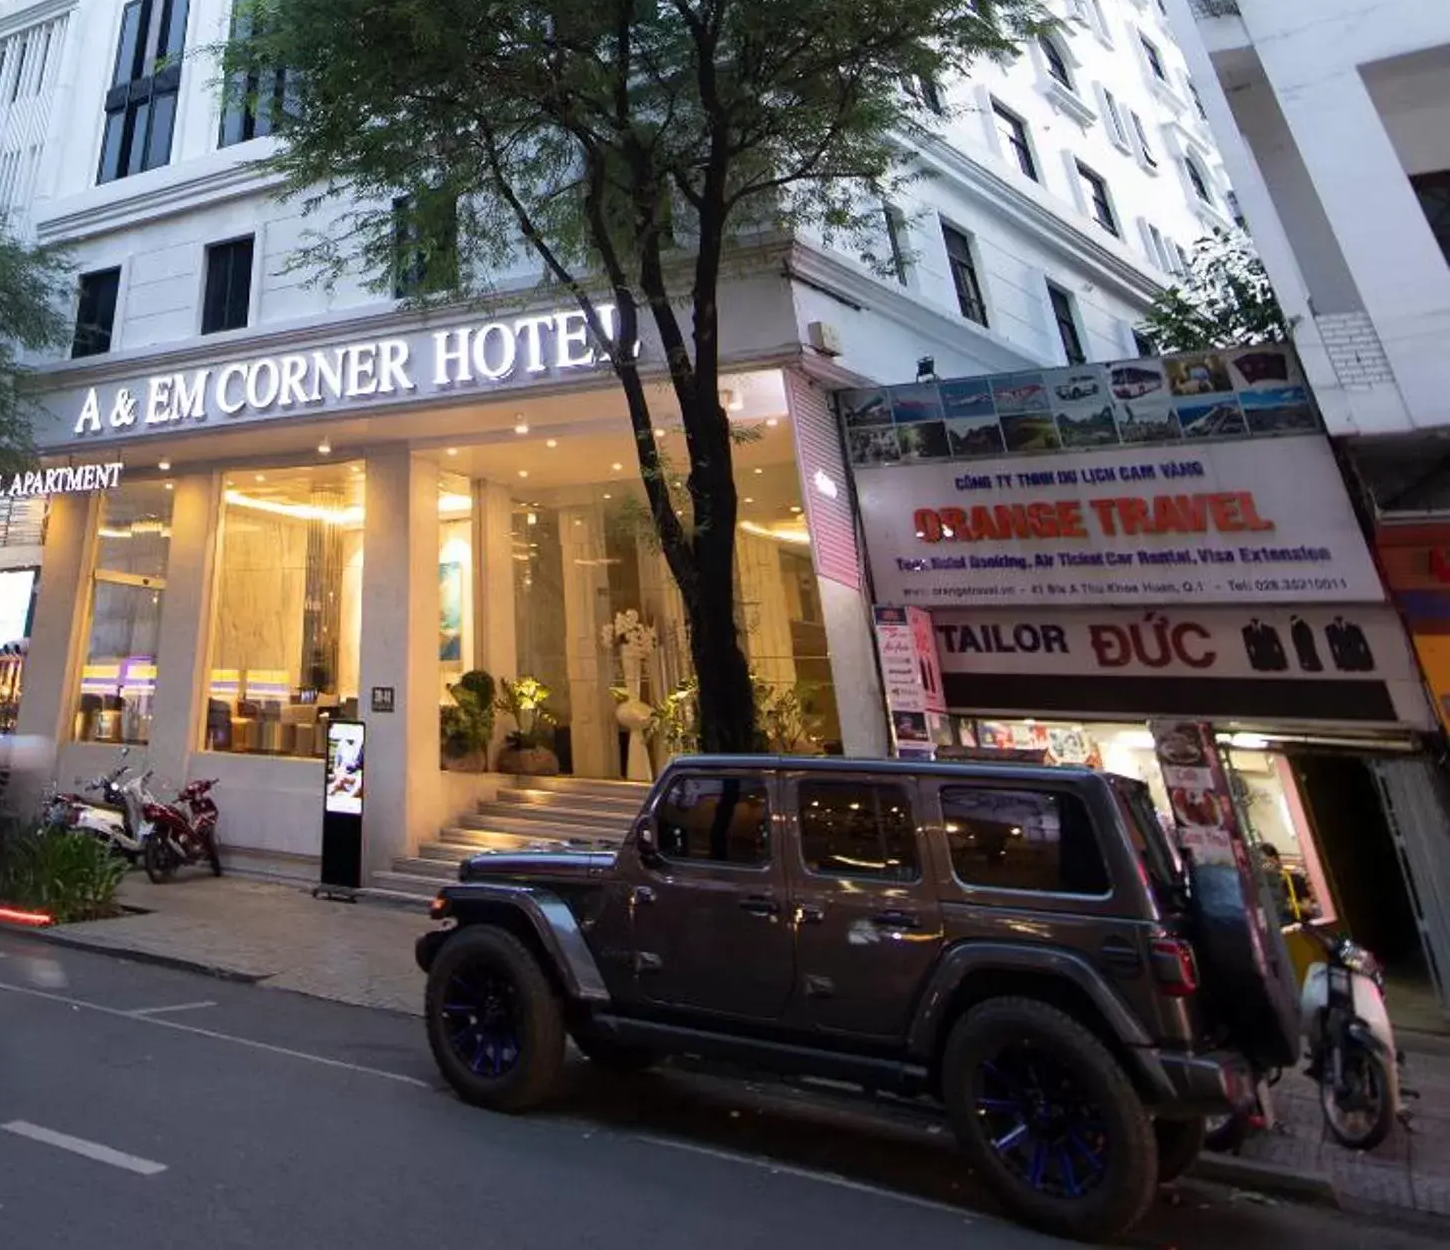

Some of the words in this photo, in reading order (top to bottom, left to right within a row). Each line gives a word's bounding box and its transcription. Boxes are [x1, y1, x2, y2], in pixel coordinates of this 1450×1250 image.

[74, 387, 102, 434] A
[110, 389, 136, 428] &
[145, 370, 211, 424] EM
[217, 339, 416, 414] CORNER
[432, 303, 641, 385] HOTEL
[8, 463, 124, 498] APARTMENT
[1118, 464, 1156, 481] CAM
[913, 502, 1090, 544] ORANGE
[1090, 491, 1276, 537] TRAVEL
[1198, 548, 1234, 563] Visa
[1238, 544, 1332, 564] Extension
[934, 623, 1071, 654] TAILOR
[1088, 609, 1217, 670] ĐỨC
